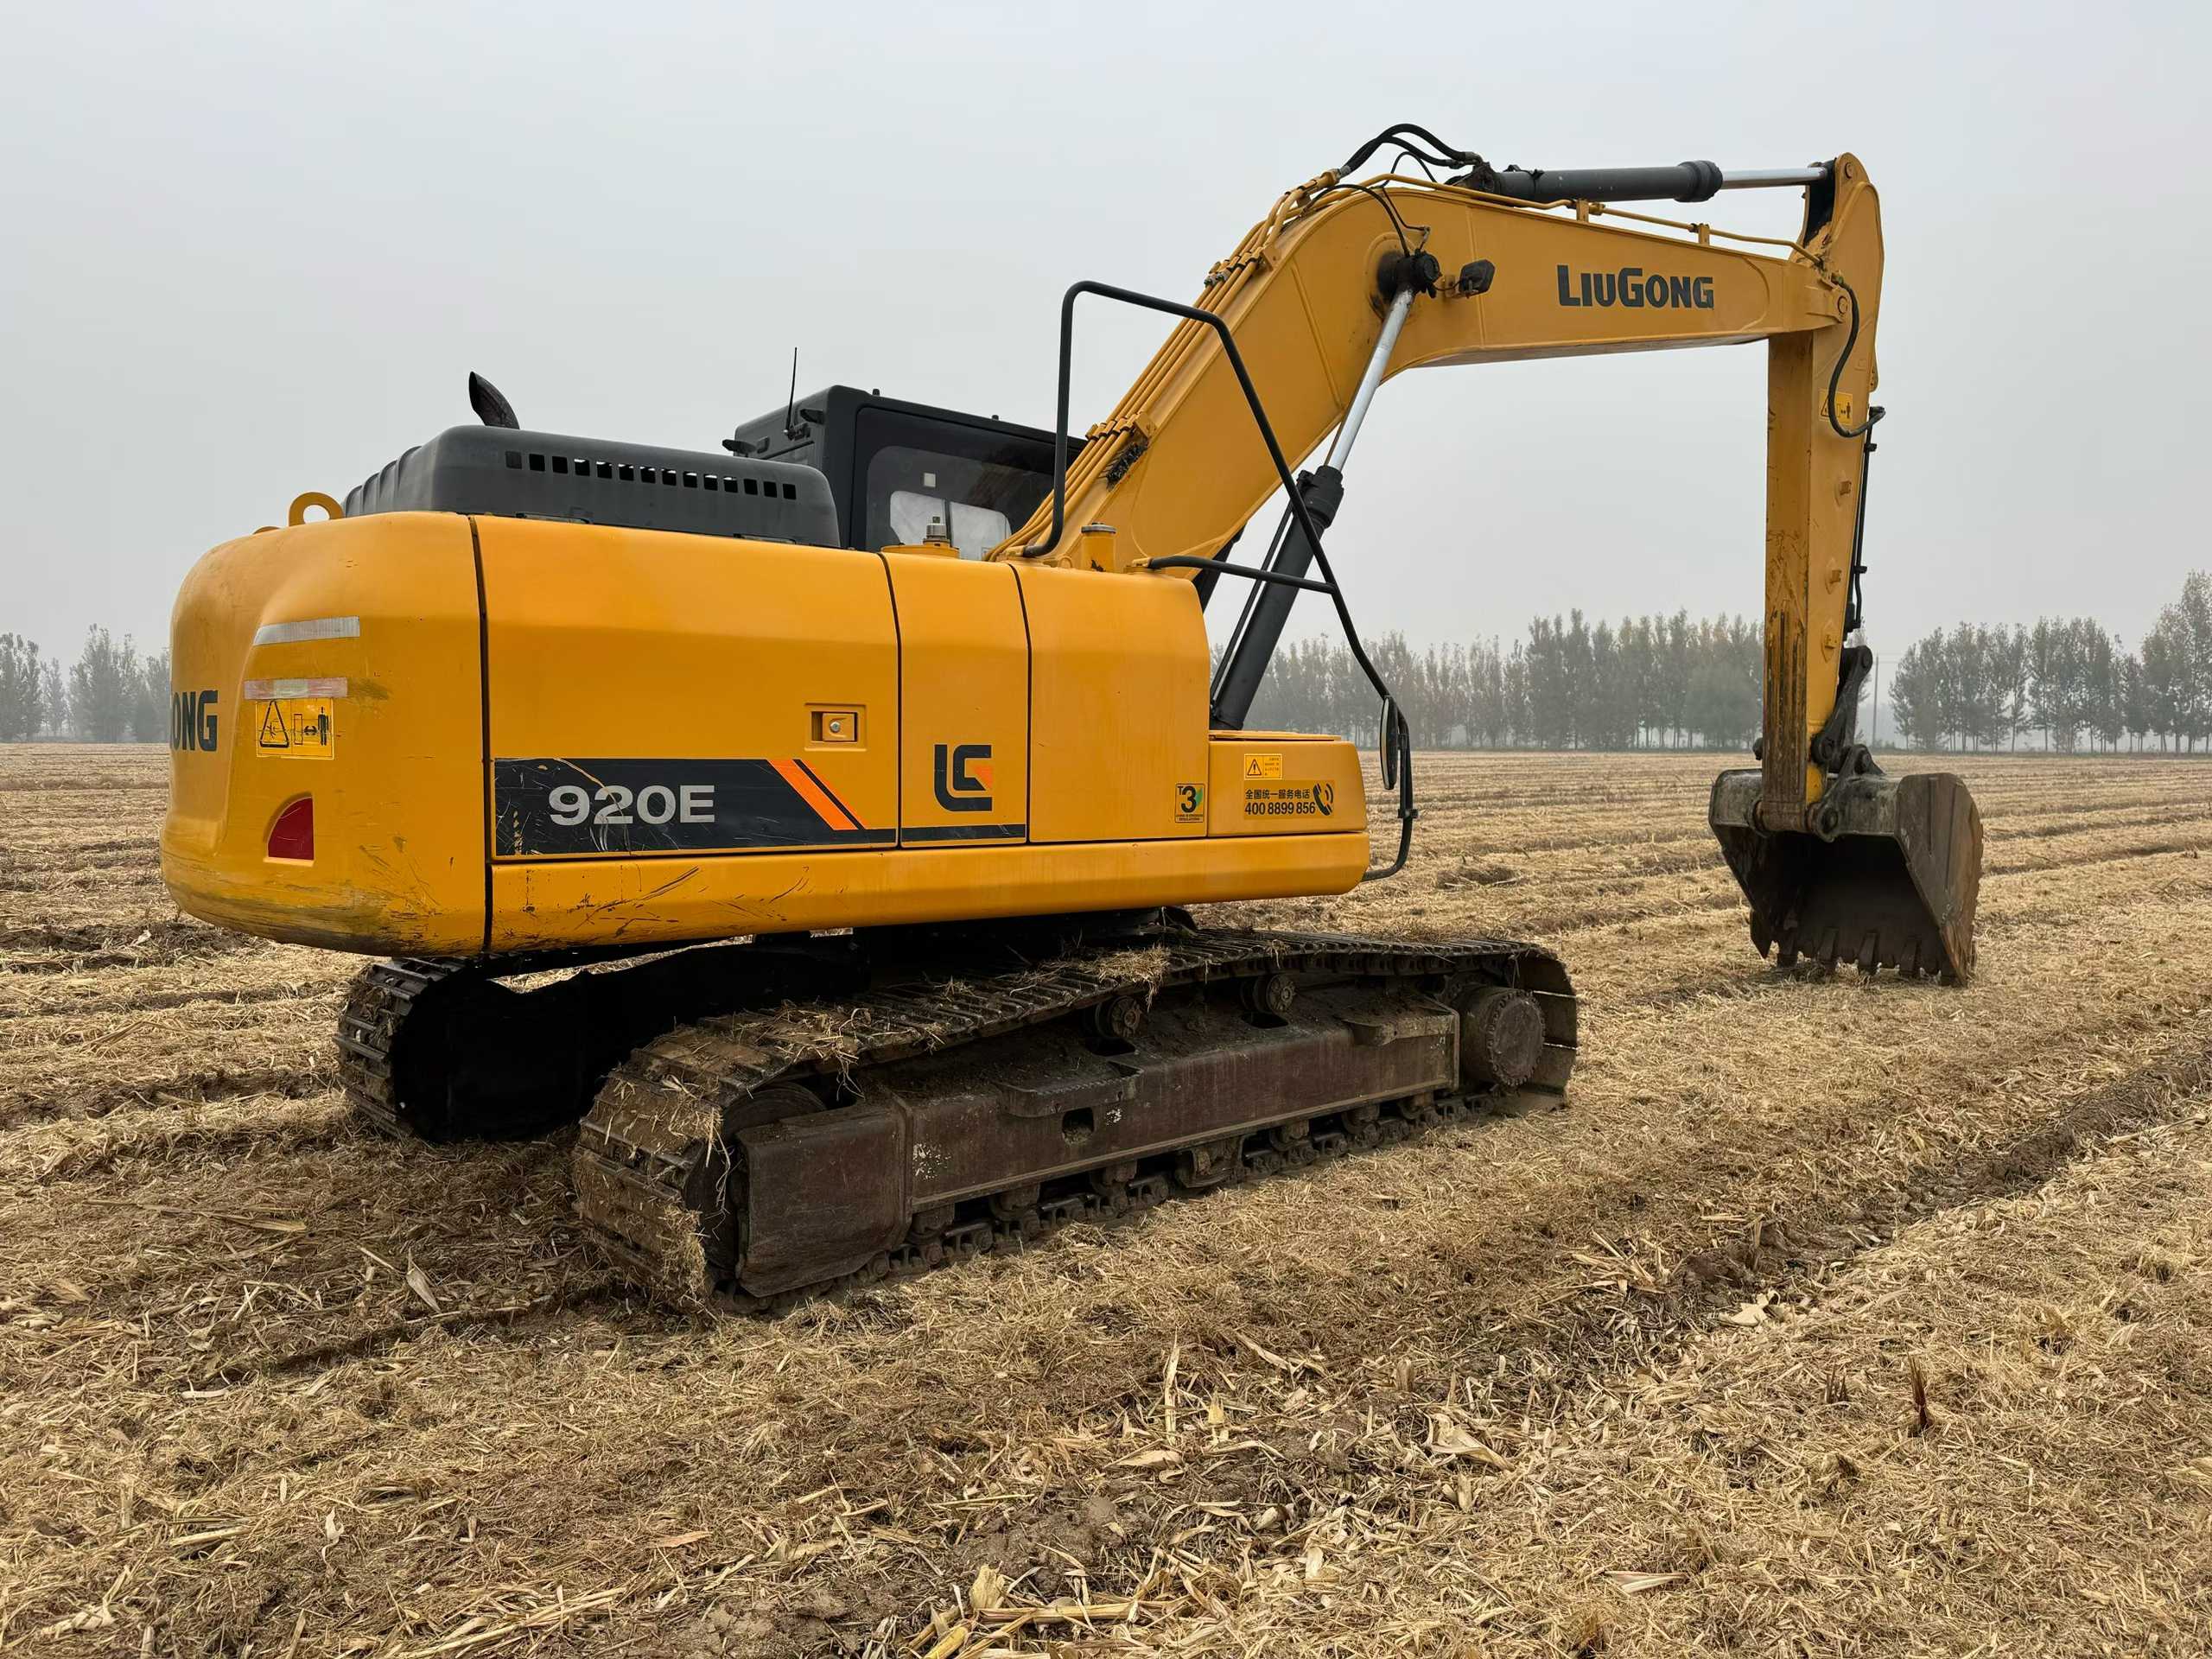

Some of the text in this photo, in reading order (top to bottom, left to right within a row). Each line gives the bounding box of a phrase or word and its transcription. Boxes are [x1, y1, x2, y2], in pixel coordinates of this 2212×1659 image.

[1245, 789, 1310, 800] 全国统一服务电话
[548, 785, 715, 825] 920E
[1244, 802, 1316, 815] 400 8899 856
